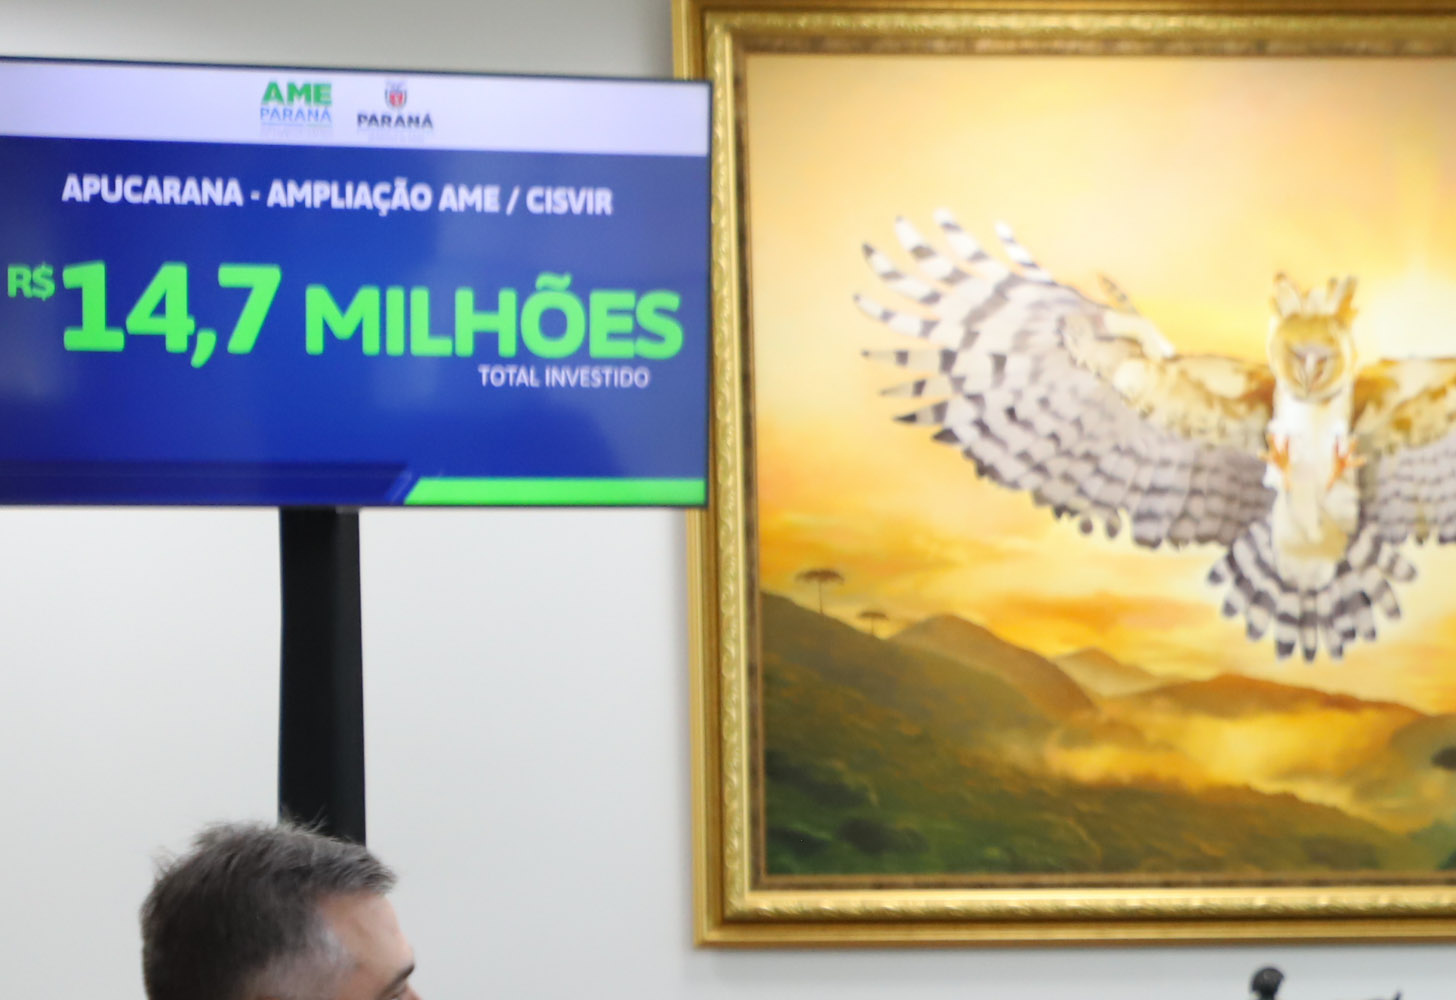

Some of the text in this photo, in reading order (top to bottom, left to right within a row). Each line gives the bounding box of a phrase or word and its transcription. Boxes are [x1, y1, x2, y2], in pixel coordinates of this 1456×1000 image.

[261, 81, 333, 106] AME
[260, 106, 333, 122] PARANÁ
[357, 112, 434, 128] PARANÁ
[62, 173, 243, 206] APUCARANA
[266, 177, 432, 216] AMPLIAÇÃO
[438, 184, 500, 213] AME
[505, 186, 520, 215] /
[525, 185, 614, 216] CISVIR
[7, 260, 684, 368] R$ 14,7 MILHÕES
[478, 365, 651, 389] TOTAL INVESTIDO
